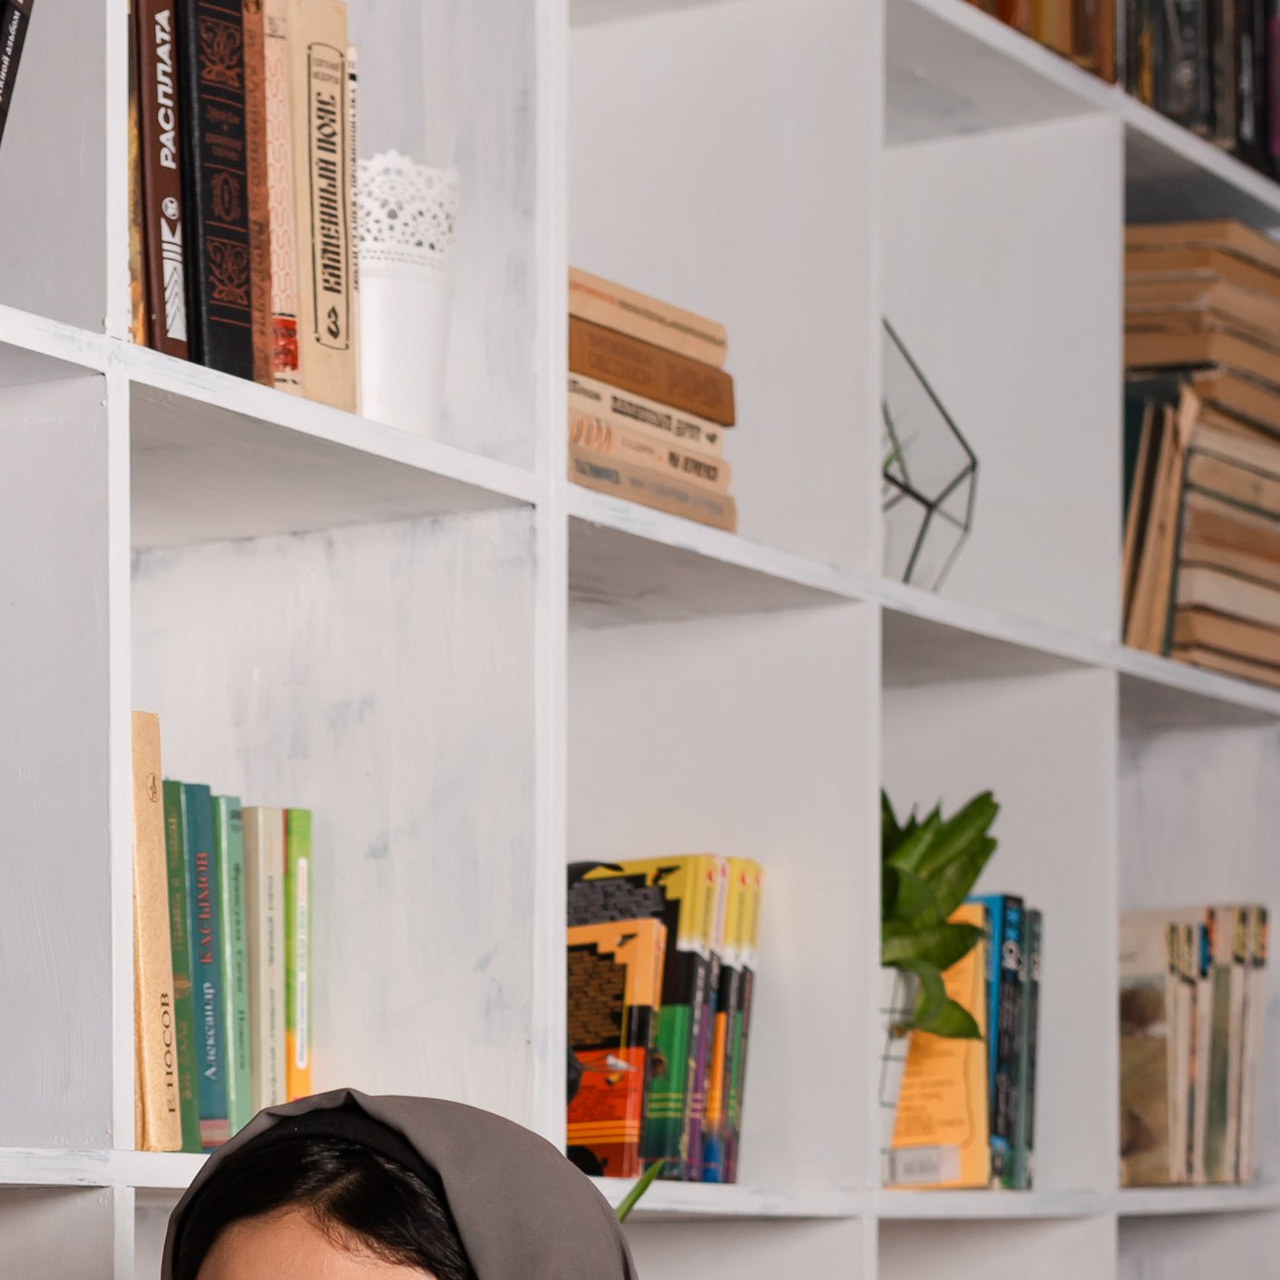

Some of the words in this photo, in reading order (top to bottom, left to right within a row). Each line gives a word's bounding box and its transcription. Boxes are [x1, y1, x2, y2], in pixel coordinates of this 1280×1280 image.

[5, 9, 21, 56] альбом
[154, 9, 177, 169] РАСПЛАТА
[315, 91, 337, 153] ПОЯС
[316, 156, 342, 295] КАМЕННЫЙ
[195, 851, 214, 964] КАСЫМОВ
[160, 992, 175, 1088] НОСОВ
[202, 981, 218, 1080] Александр
